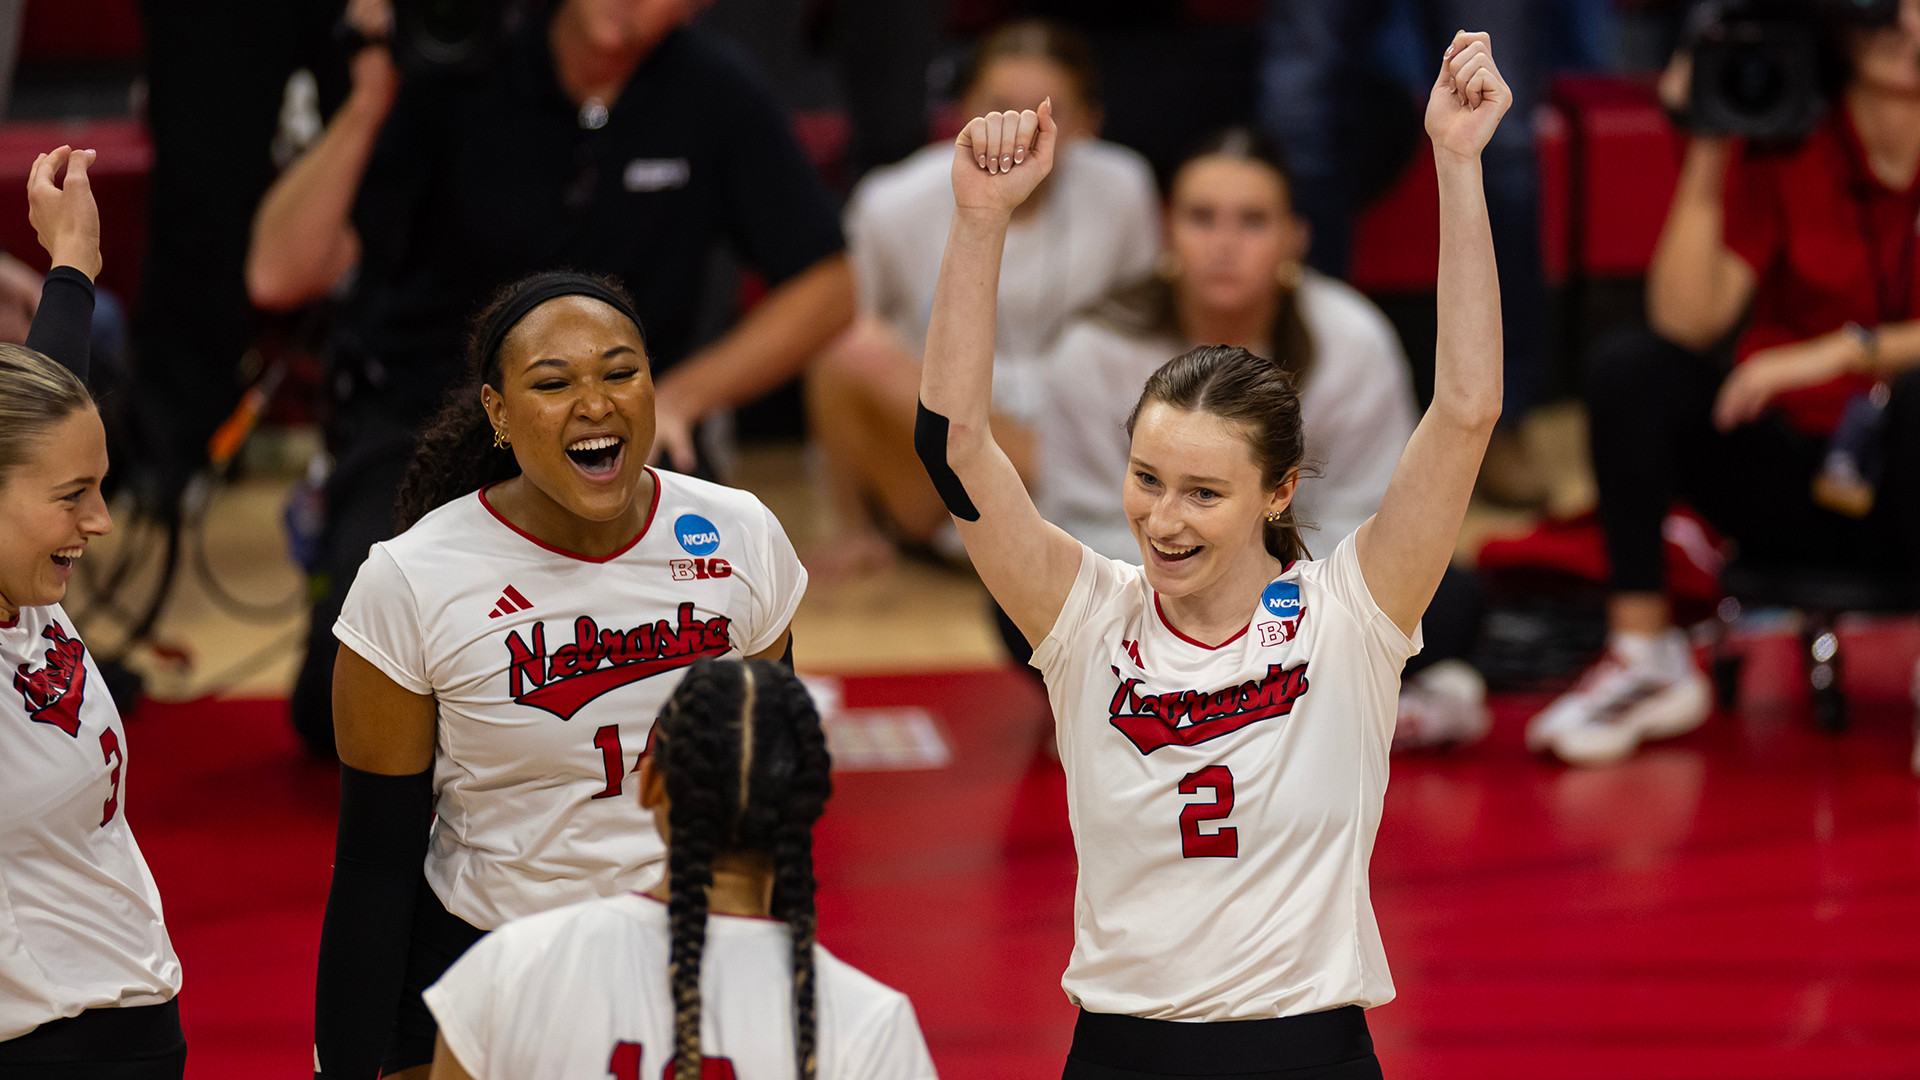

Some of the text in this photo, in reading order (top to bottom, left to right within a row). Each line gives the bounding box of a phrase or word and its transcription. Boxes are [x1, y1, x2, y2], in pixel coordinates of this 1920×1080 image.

[682, 532, 719, 546] NCAA
[505, 602, 732, 698] Nebraska
[1269, 598, 1300, 609] NCA
[99, 726, 123, 828] 3
[1178, 764, 1238, 859] 2
